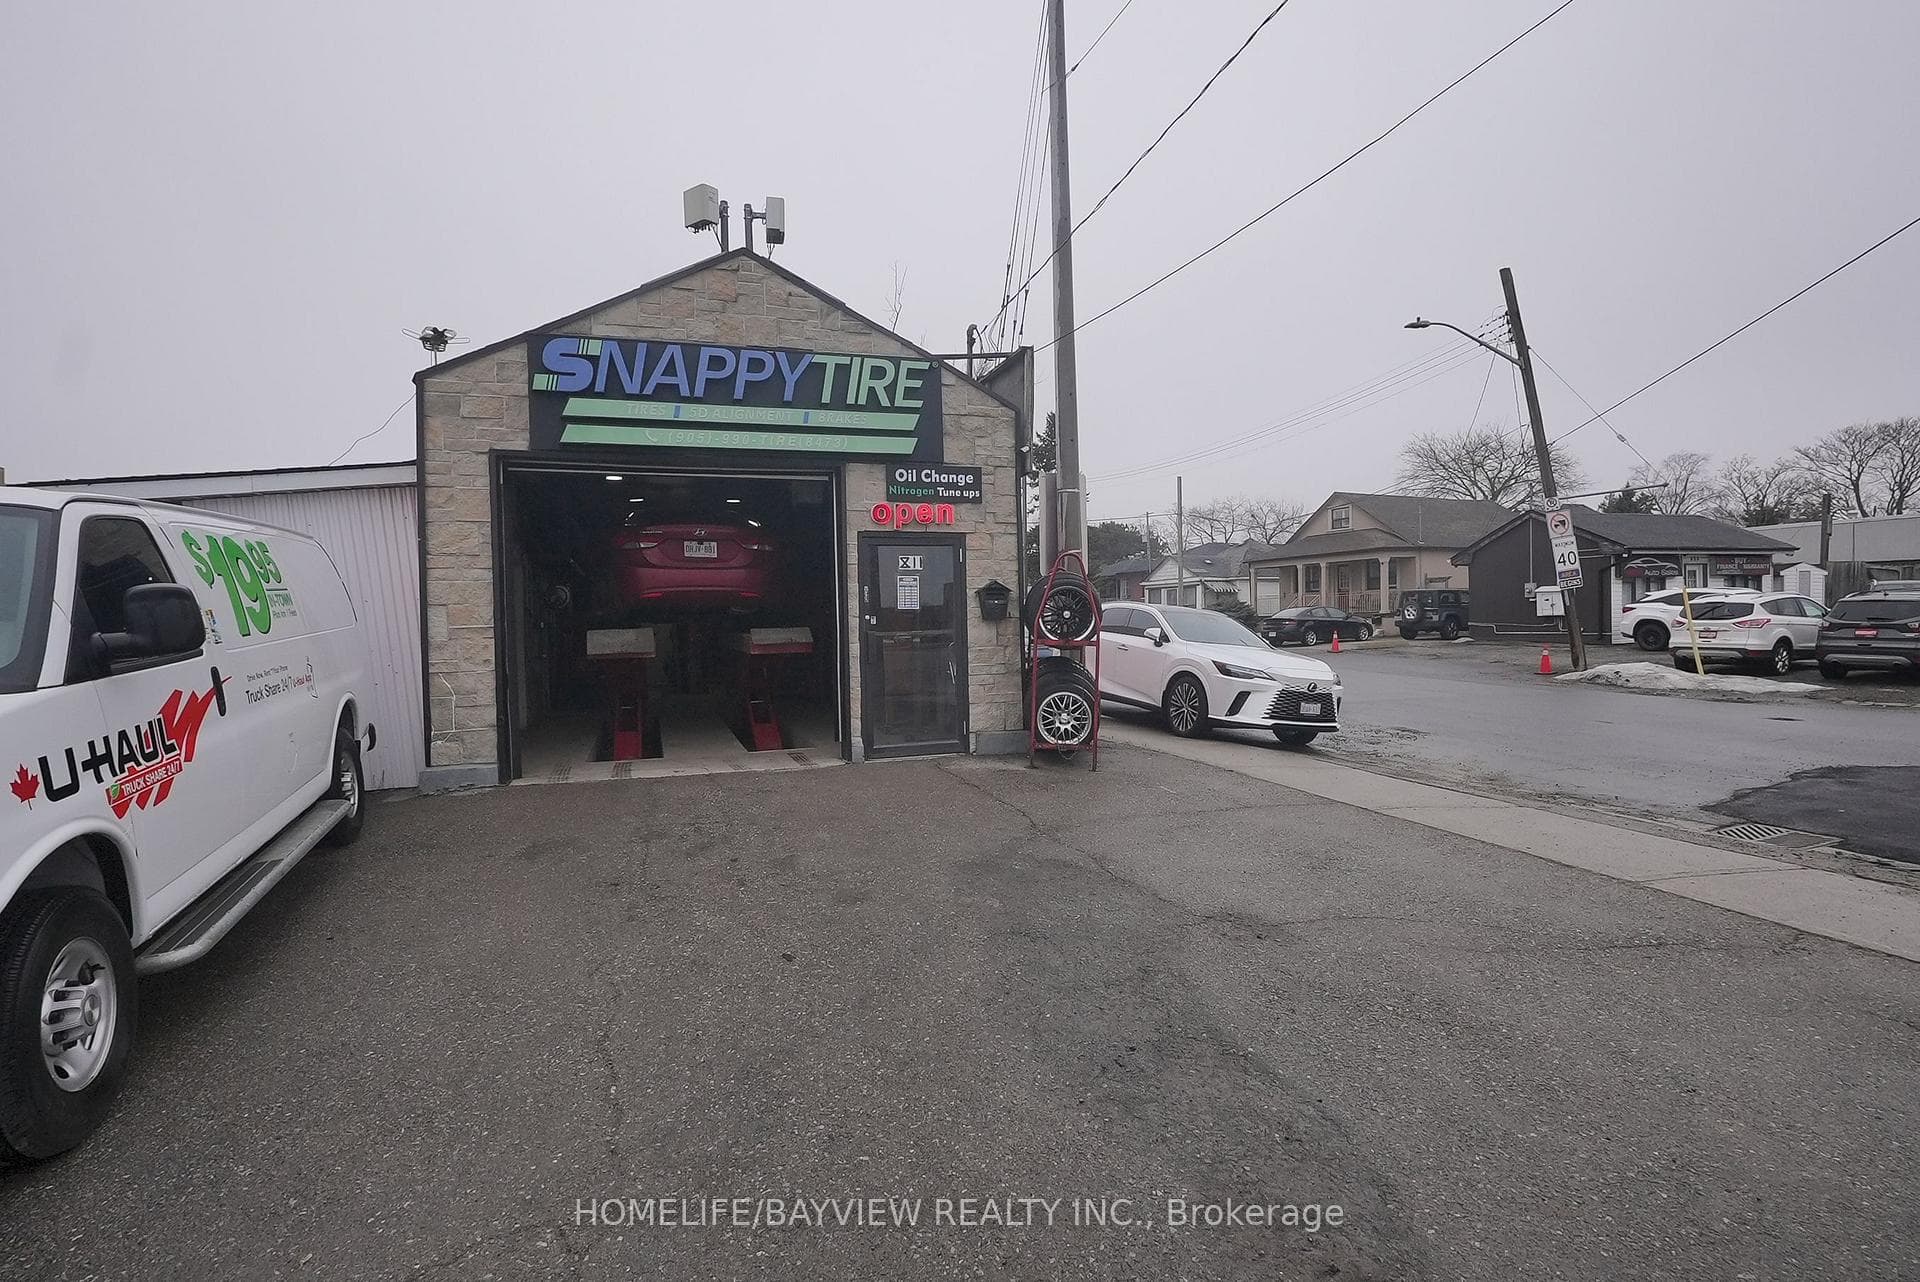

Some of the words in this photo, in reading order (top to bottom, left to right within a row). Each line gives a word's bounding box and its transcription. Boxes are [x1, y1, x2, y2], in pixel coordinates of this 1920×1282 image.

[626, 403, 666, 417] TIRES
[711, 407, 793, 421] ALIGNMENT
[817, 411, 868, 425] BRAKES
[895, 468, 917, 482] Oil
[921, 469, 974, 486] Change
[888, 485, 935, 497] Nitrogen
[937, 487, 961, 497] Tune
[963, 490, 980, 499] ups
[871, 502, 955, 530] open
[1558, 551, 1577, 566] 40
[245, 686, 264, 704] Truck
[264, 683, 281, 698] Share
[121, 776, 146, 796] TRUCK
[145, 766, 168, 785] SHARE
[166, 760, 180, 775] 24/7
